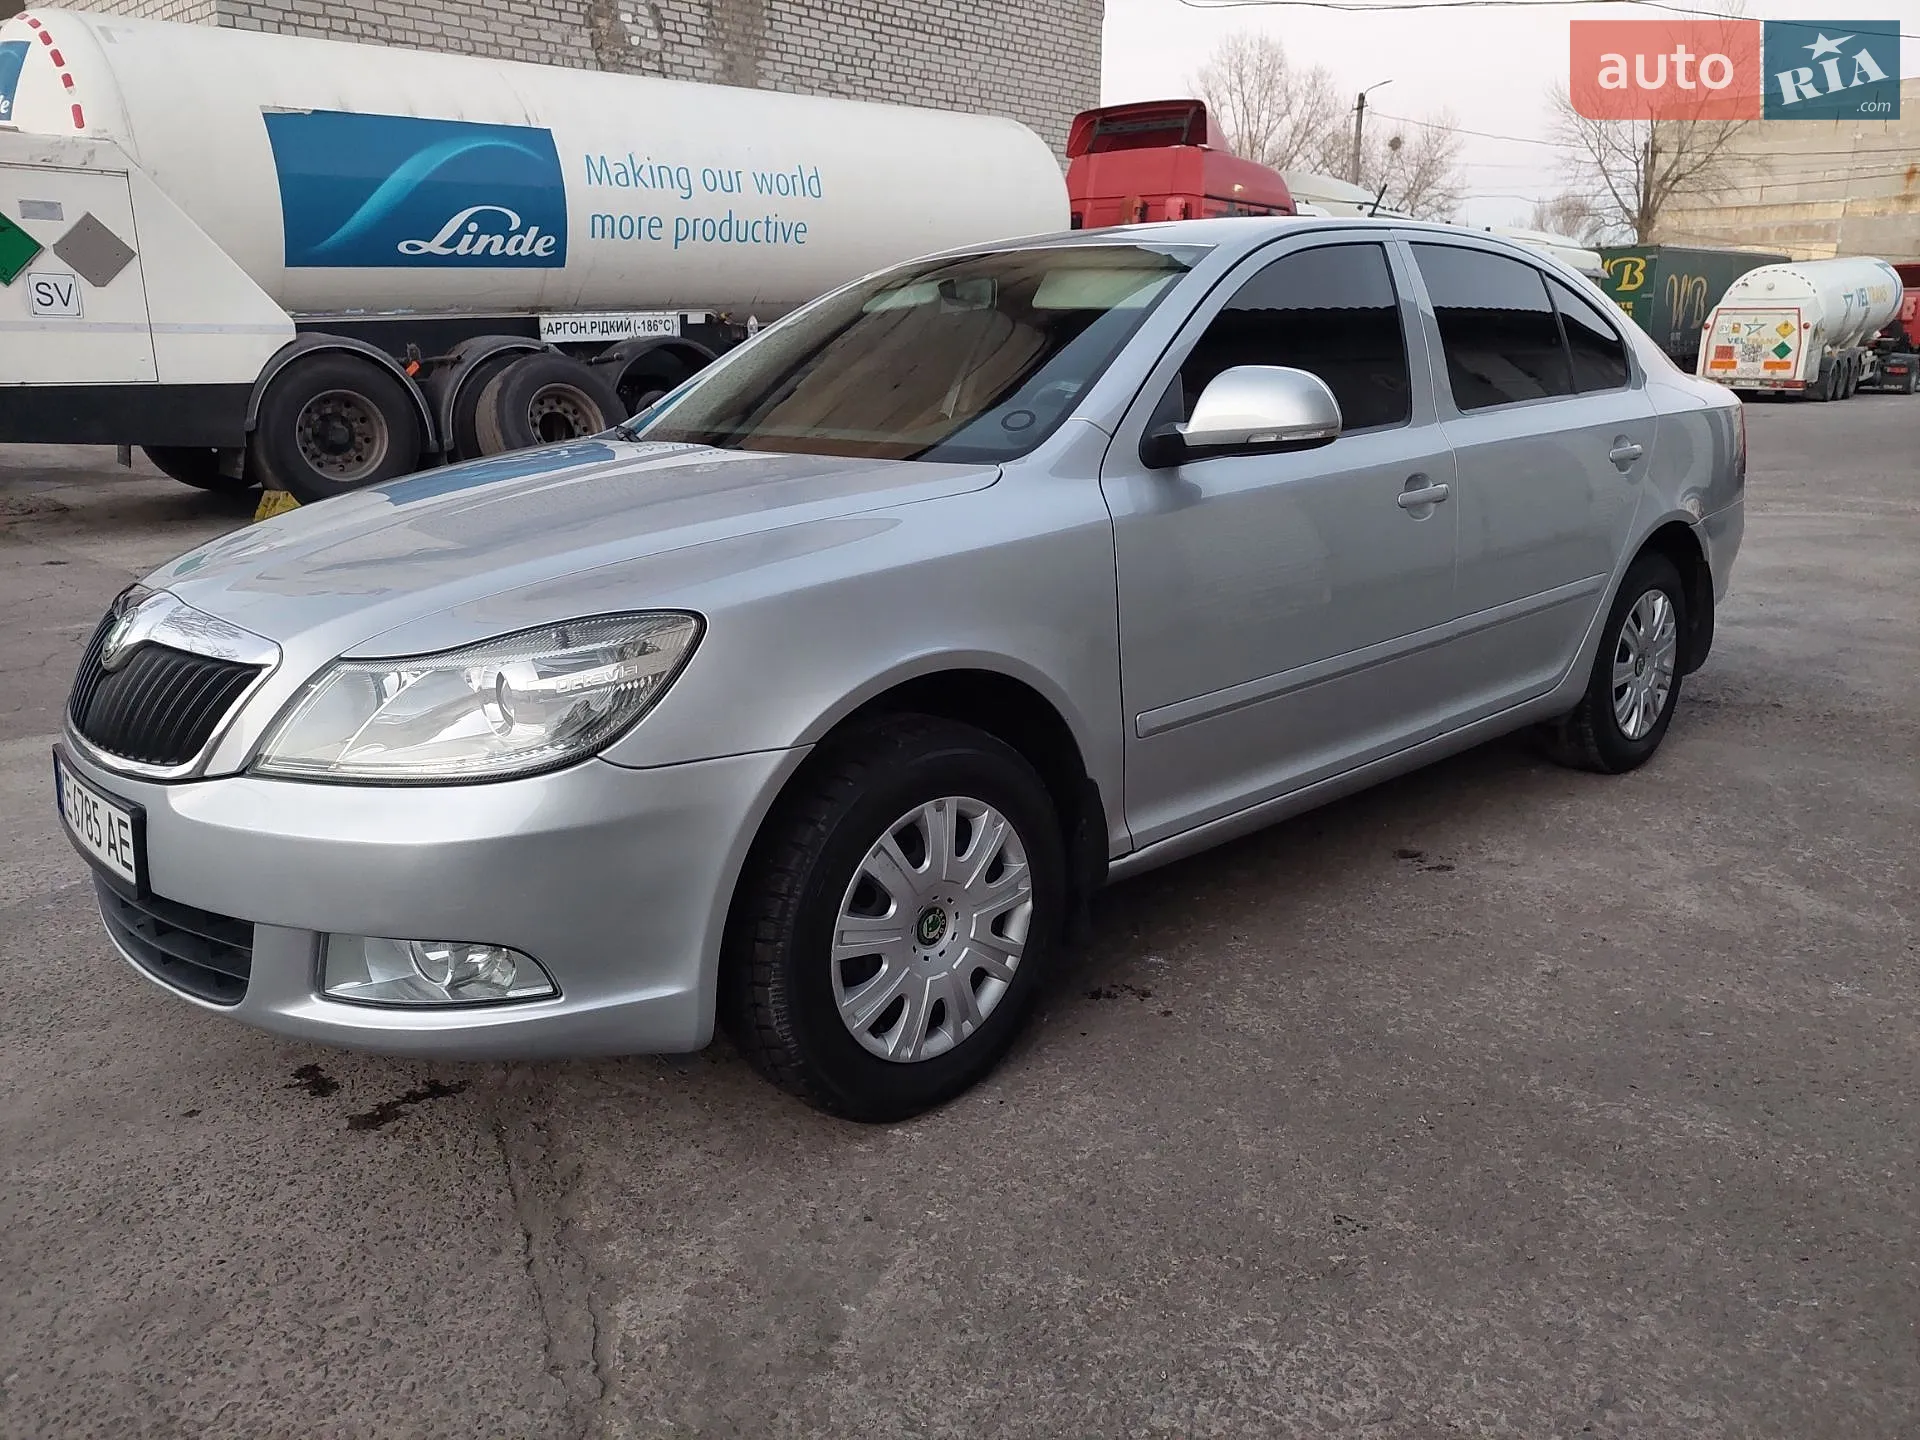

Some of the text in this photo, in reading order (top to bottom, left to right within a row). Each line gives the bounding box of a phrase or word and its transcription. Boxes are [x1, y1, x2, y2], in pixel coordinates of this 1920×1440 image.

[585, 153, 822, 200] Making our world
[397, 205, 556, 257] Linde
[590, 209, 808, 250] more productive
[35, 282, 73, 307] SV
[591, 318, 632, 336] РІДКИЙ
[73, 783, 102, 848] 6785
[107, 811, 133, 872] AE
